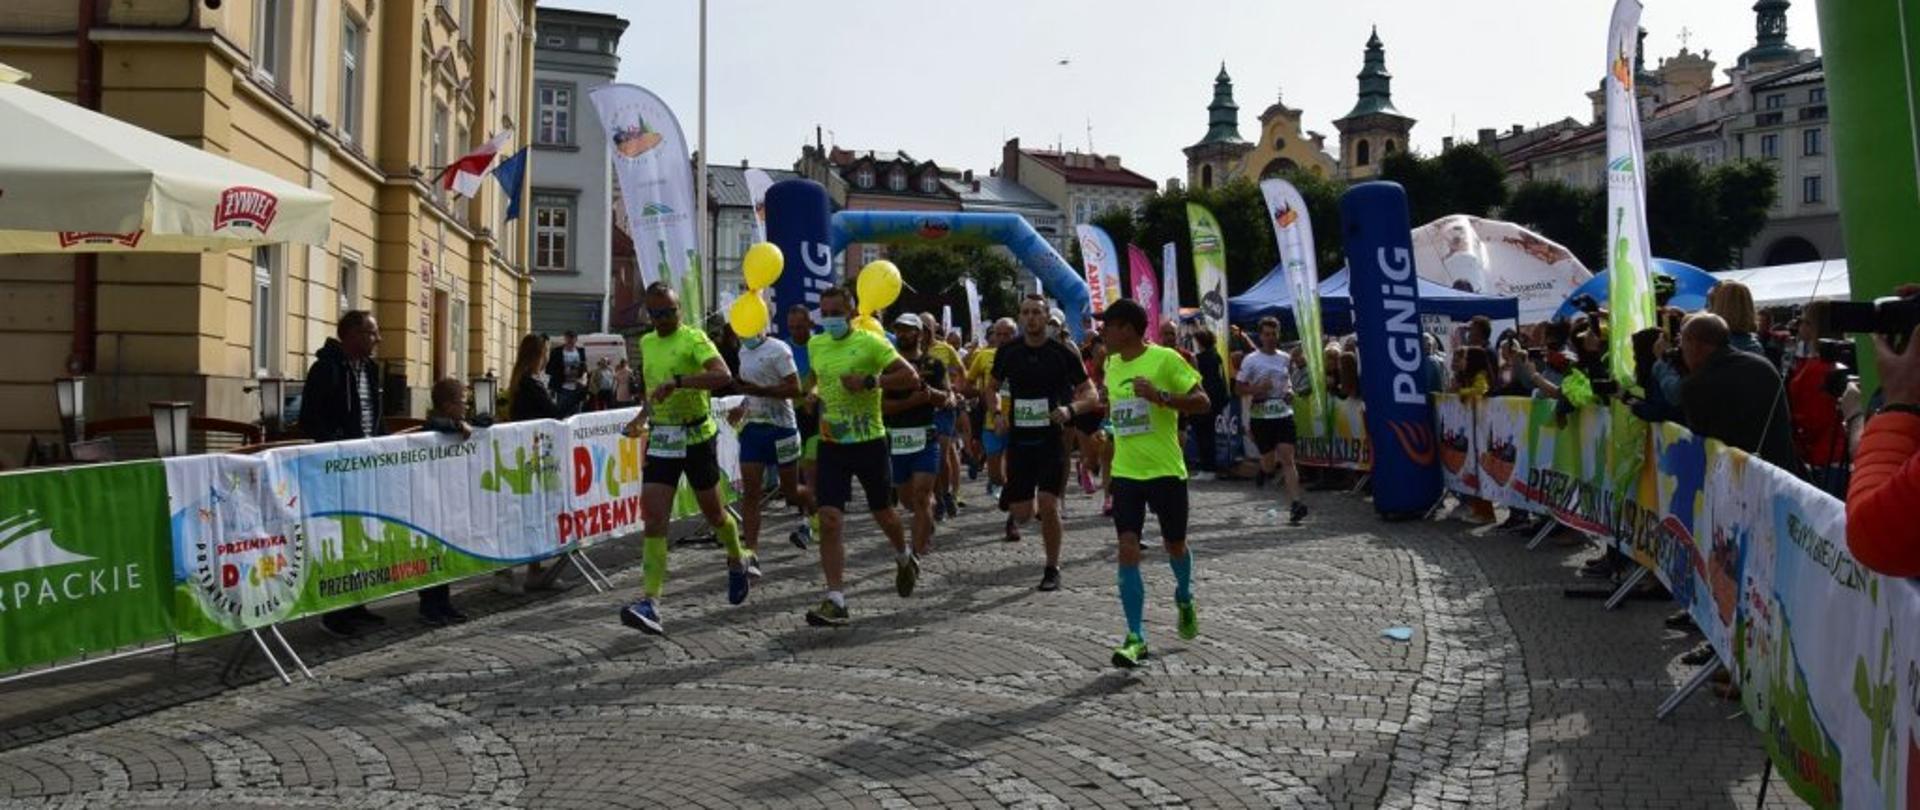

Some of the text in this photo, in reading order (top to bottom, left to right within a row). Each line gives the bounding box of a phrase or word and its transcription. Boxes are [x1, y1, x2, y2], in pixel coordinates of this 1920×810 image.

[224, 189, 274, 220] ŻYWIEC
[1378, 247, 1427, 404] PGNiG
[325, 442, 477, 474] PRZEMYSKI BIEG ULICZNY
[573, 436, 640, 497] DYCH
[556, 495, 640, 544] PRZEMY
[217, 534, 288, 556] PRZEMYSKA
[222, 553, 288, 588] DYCHA
